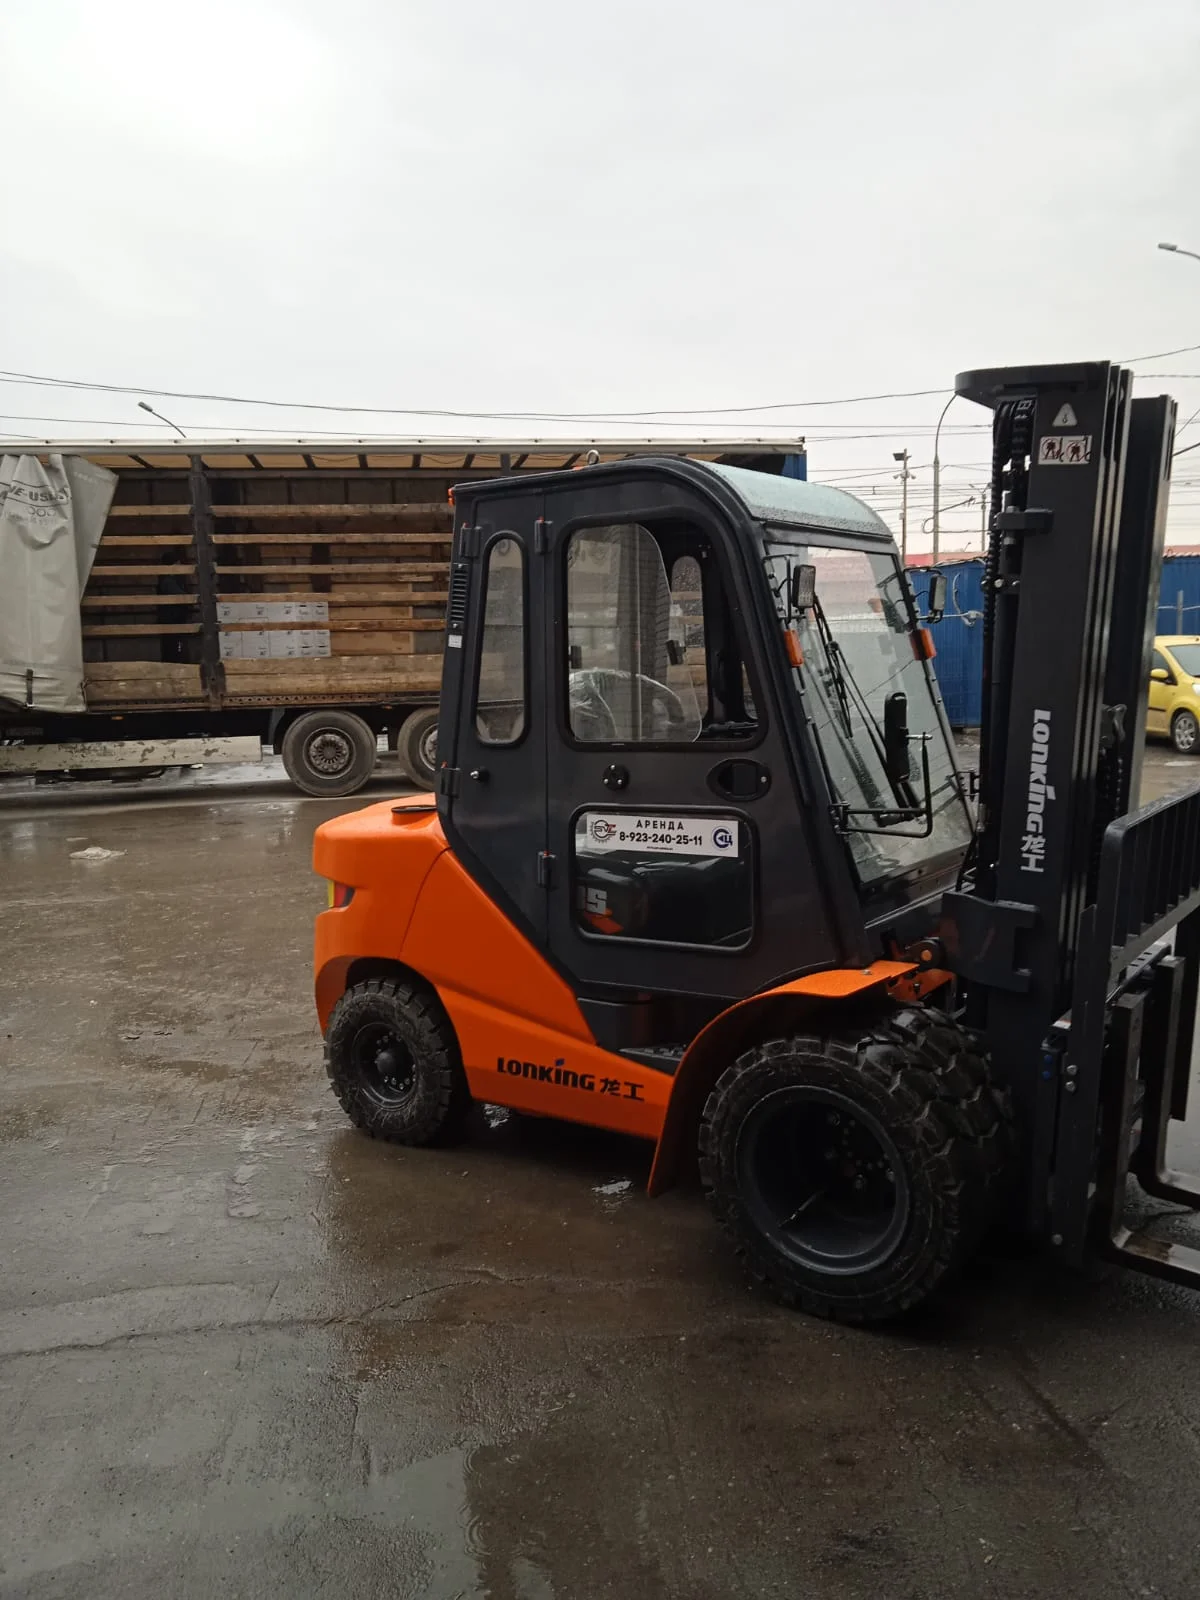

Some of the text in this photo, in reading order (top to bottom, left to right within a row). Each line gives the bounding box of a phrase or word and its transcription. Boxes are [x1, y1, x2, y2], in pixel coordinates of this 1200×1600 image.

[636, 819, 684, 830] АРЕНДА
[619, 831, 702, 846] 8-923-240-25-11
[1020, 834, 1046, 872] 龙工
[600, 1078, 645, 1101] 龙工
